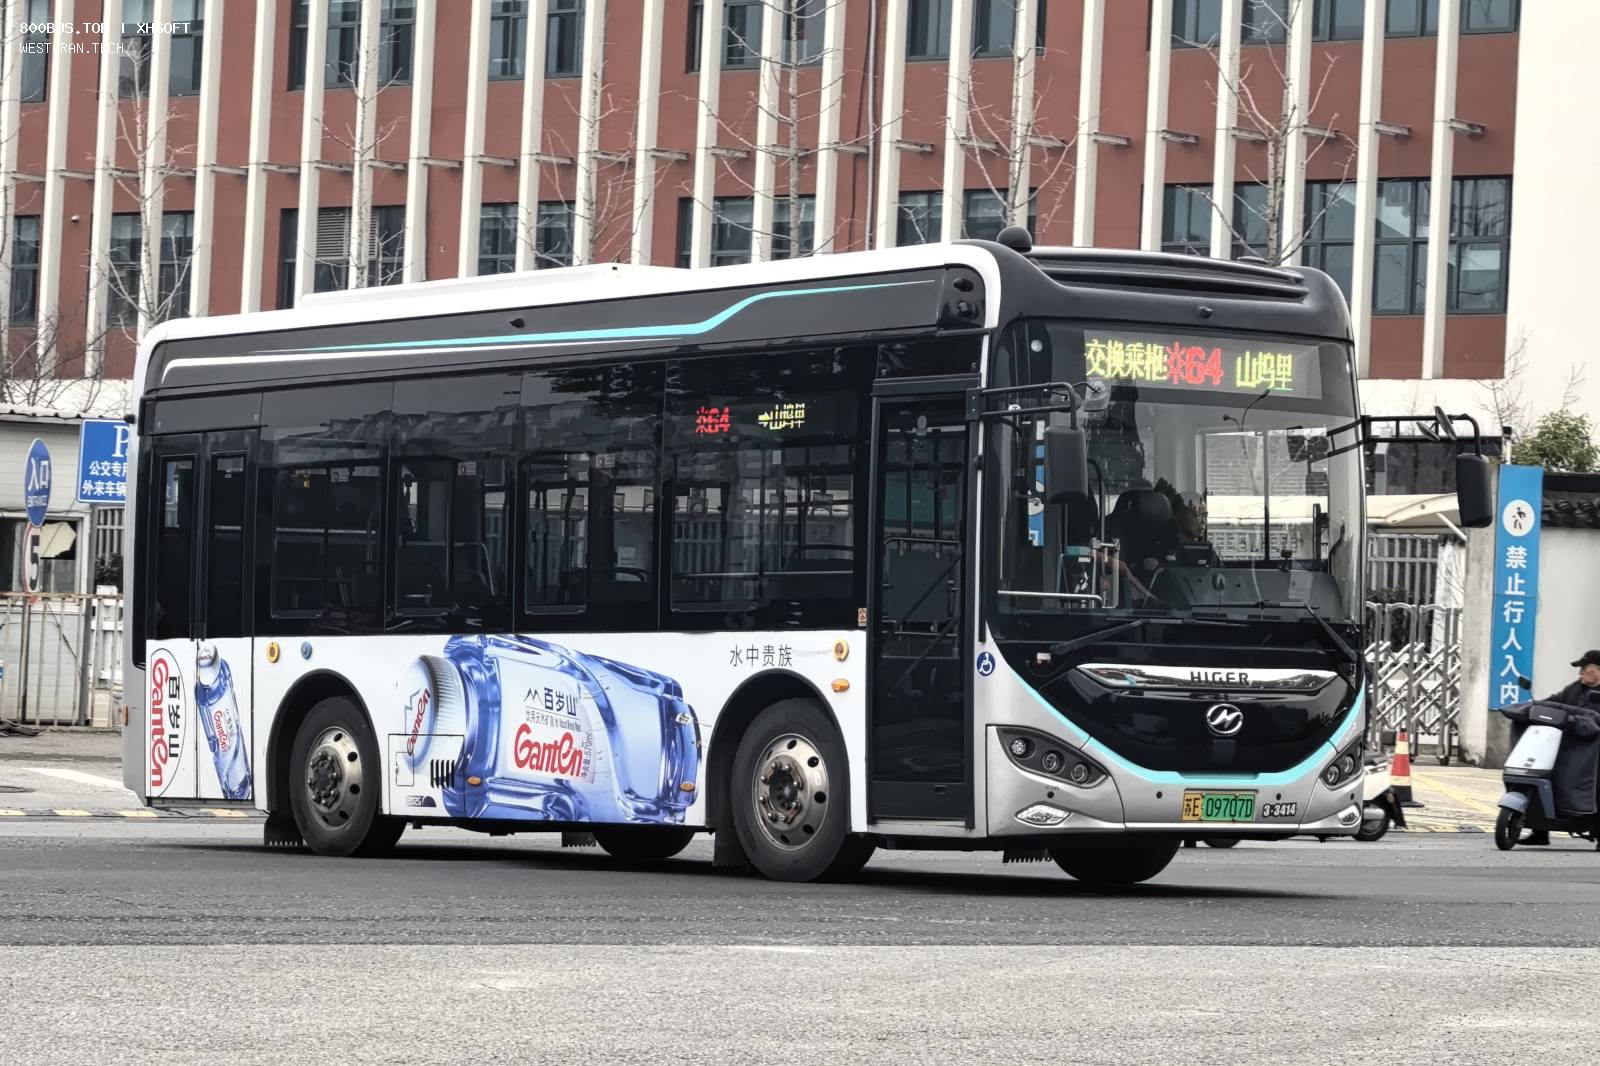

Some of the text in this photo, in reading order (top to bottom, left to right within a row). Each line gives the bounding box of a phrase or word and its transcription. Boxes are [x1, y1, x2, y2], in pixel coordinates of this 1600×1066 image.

[1236, 350, 1294, 391] 山坞里
[28, 458, 49, 491] 入口
[1500, 546, 1527, 704] 禁止行人入内
[729, 644, 793, 667] 水中贵族
[1190, 671, 1249, 685] HIGER
[168, 676, 181, 758] 百岁山
[543, 687, 576, 716] 百岁山
[514, 723, 583, 778] Ganten
[1184, 798, 1201, 817] 苏E
